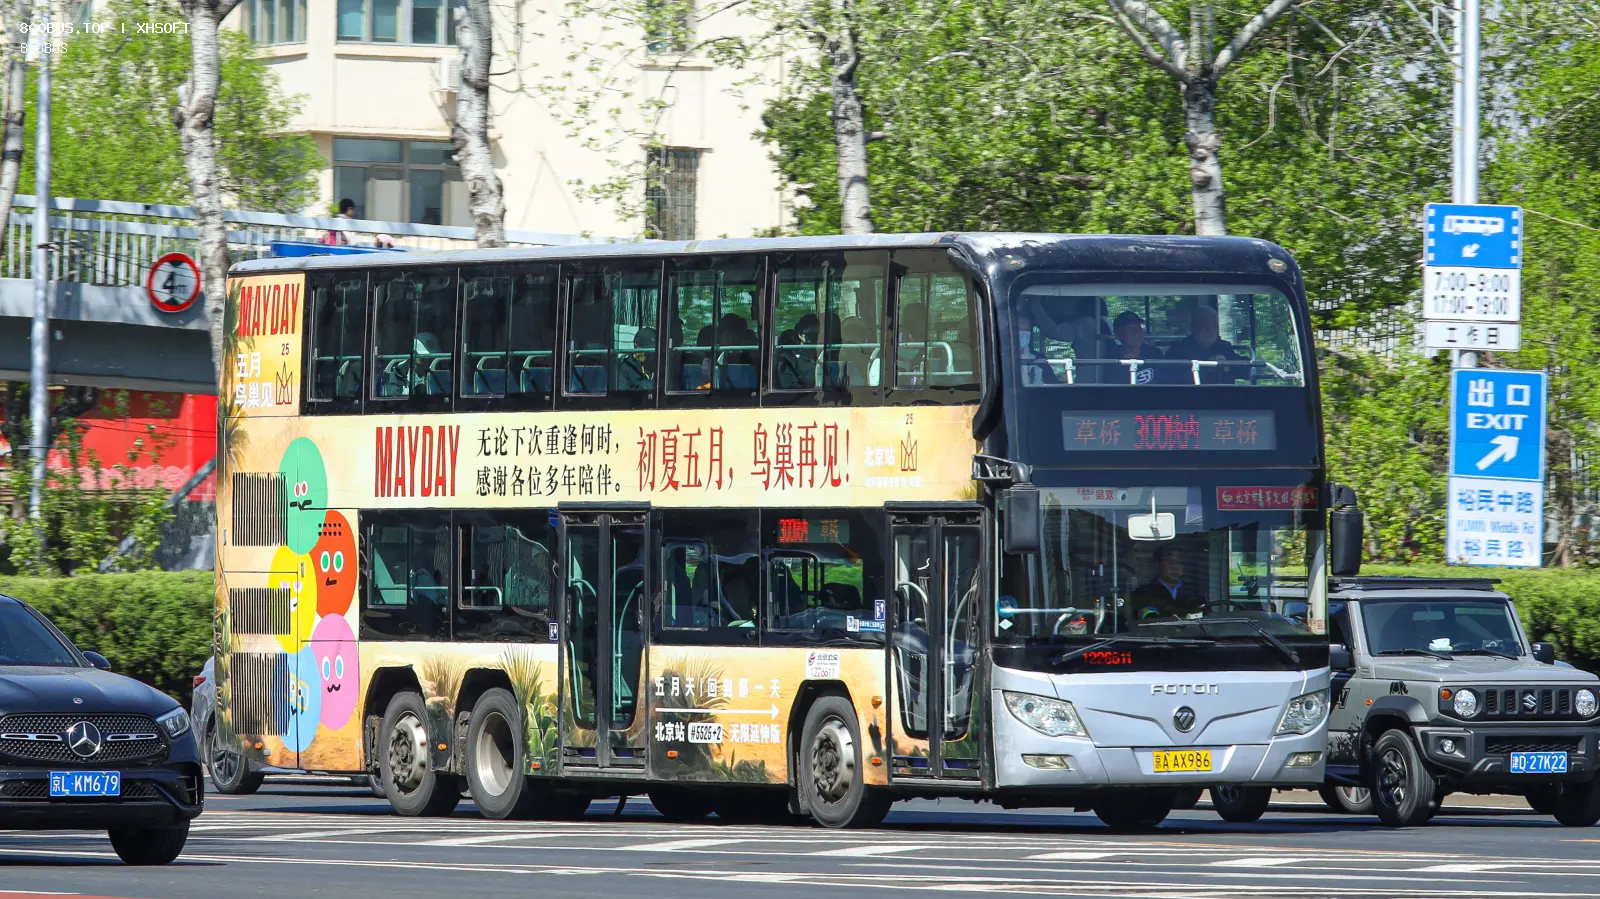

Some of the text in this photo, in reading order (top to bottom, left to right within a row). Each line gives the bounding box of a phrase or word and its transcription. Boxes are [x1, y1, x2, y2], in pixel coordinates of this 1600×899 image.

[238, 283, 301, 337] MAYDAY
[1446, 325, 1499, 345] 工作日
[281, 343, 290, 356] 25
[236, 352, 261, 378] 五月
[234, 381, 274, 409] 鸟巢见
[1467, 378, 1531, 408] 出口
[905, 413, 914, 425] 25
[1466, 412, 1529, 430] EXIT
[374, 425, 461, 498] MAYDAY
[475, 463, 621, 497] 感谢各位多年陪伴。
[1457, 488, 1534, 514] 裕民中路
[1150, 683, 1219, 696] FOTON
[655, 721, 685, 742] 北京站
